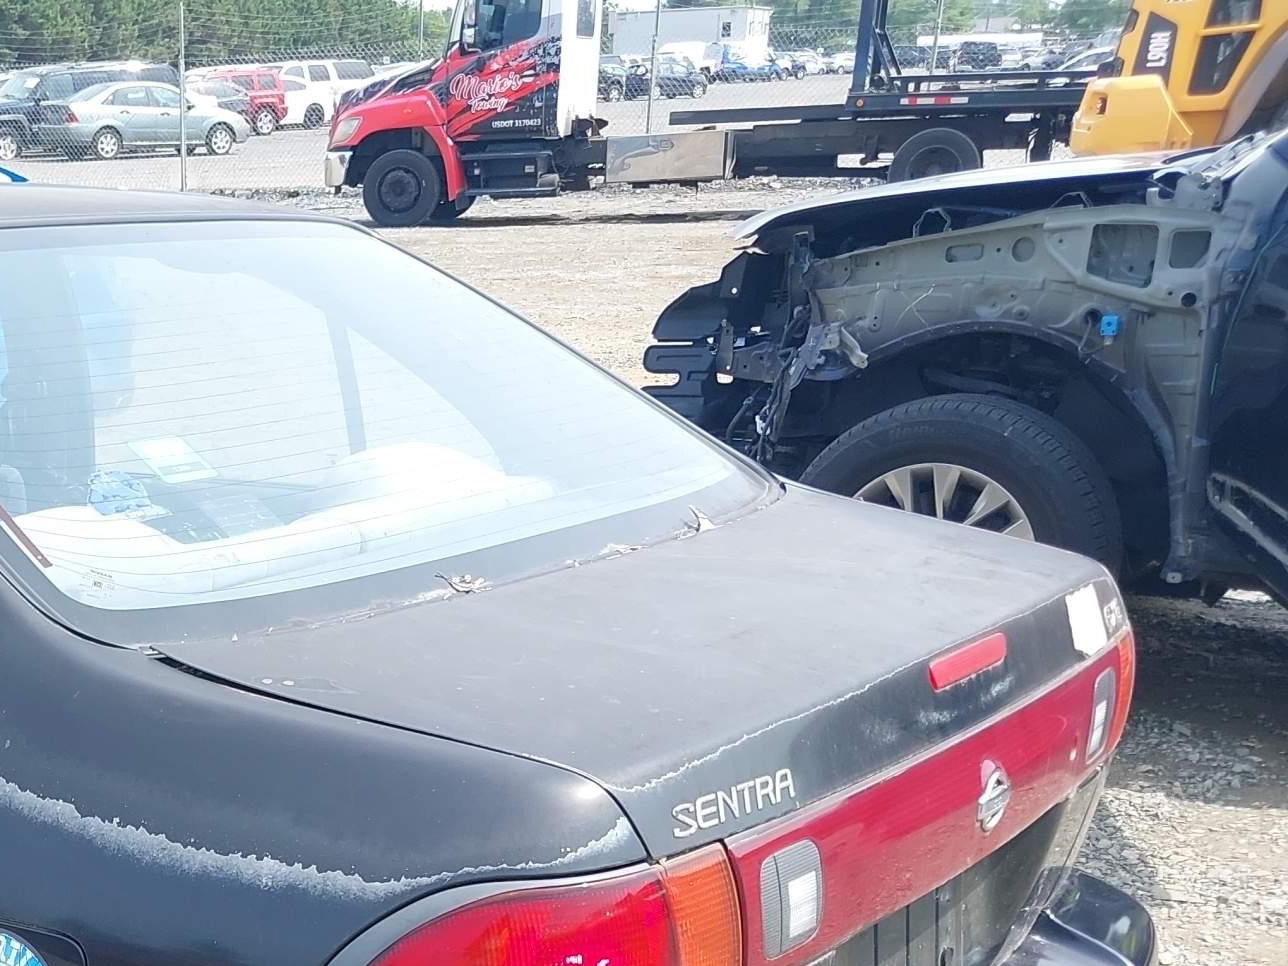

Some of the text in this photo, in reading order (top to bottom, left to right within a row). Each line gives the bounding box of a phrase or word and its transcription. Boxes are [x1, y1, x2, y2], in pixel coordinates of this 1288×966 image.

[468, 96, 509, 113] Towing
[491, 120, 513, 128] USDOT
[672, 768, 797, 838] SENTRA
